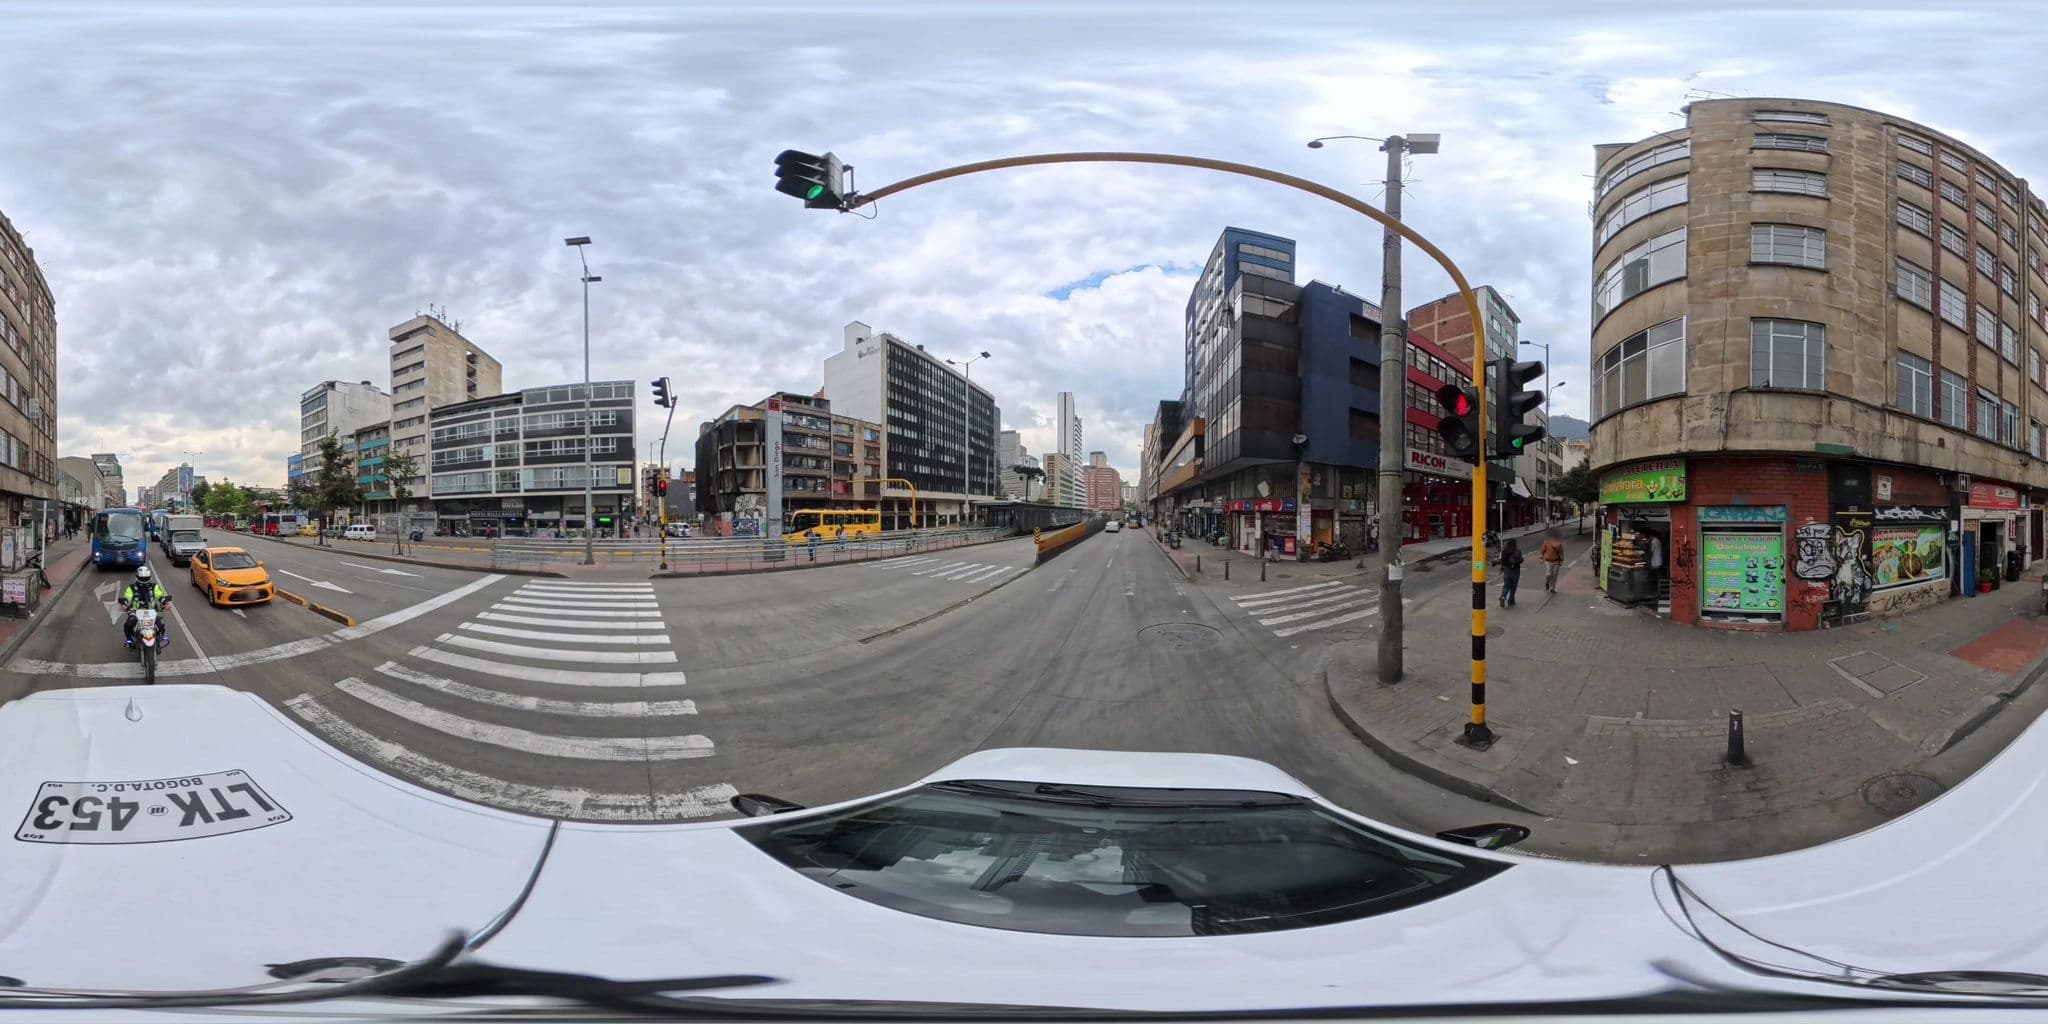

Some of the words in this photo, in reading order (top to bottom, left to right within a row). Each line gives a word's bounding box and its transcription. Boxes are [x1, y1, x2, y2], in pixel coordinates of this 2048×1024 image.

[773, 441, 782, 463] Diego
[1411, 451, 1446, 470] RICOH
[1623, 459, 1681, 476] AFETERIA
[33, 795, 141, 832] 453
[165, 782, 275, 828] LTK
